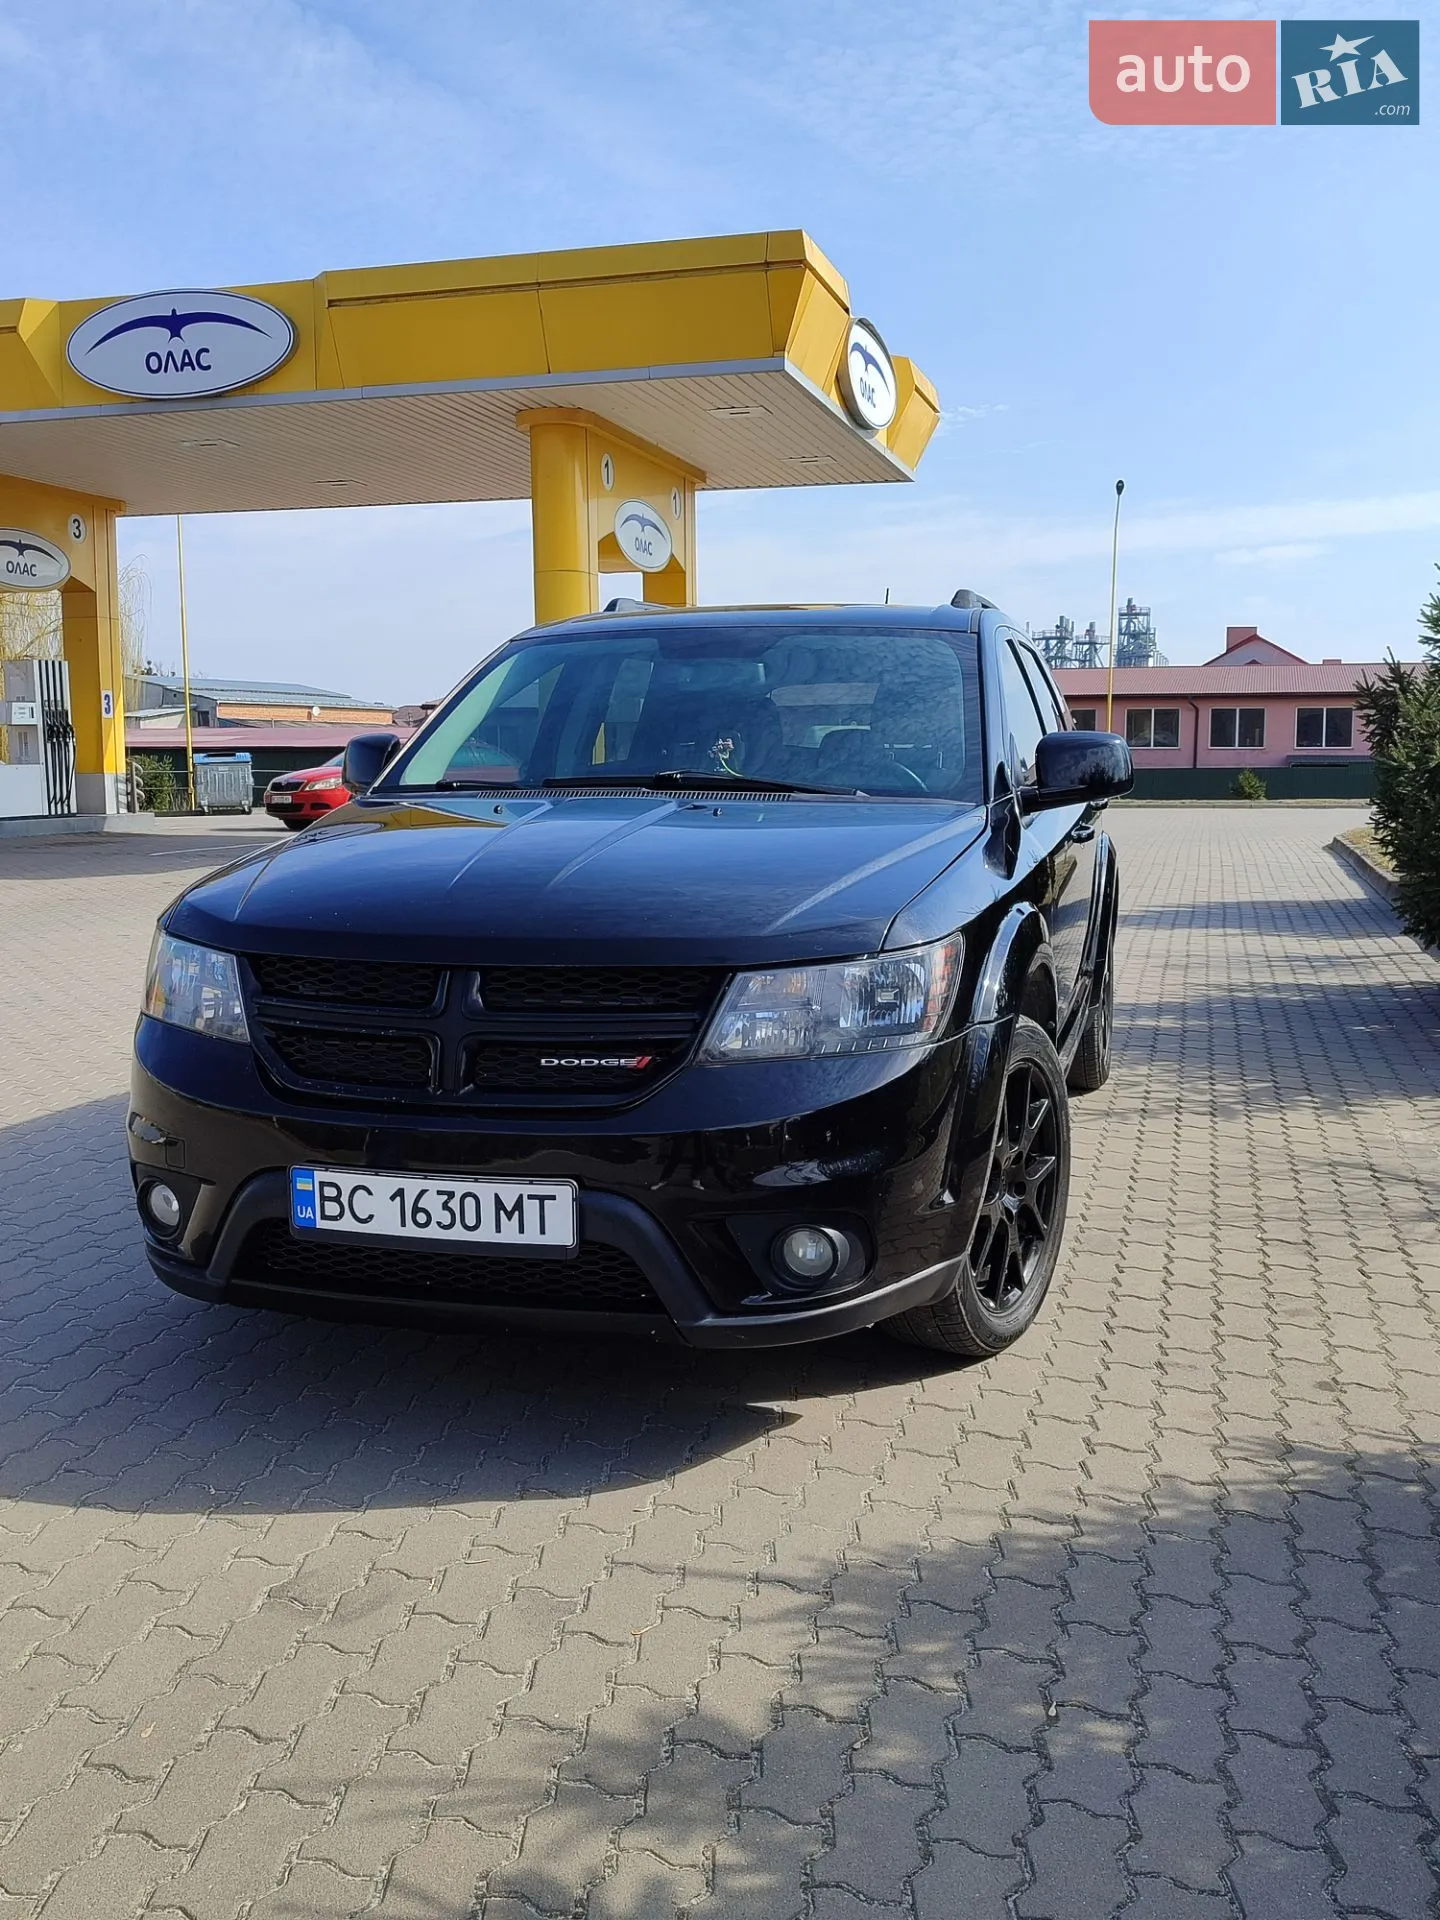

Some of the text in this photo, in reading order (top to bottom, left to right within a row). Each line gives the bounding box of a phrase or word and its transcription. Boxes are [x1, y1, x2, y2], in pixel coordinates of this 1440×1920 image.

[145, 347, 212, 375] ОЛАС
[604, 459, 610, 485] 1
[673, 491, 678, 516] 1
[72, 518, 82, 539] 3
[635, 537, 653, 556] ОЛАС
[6, 560, 37, 577] ОЛАС
[104, 693, 111, 715] 3
[540, 1058, 638, 1066] DODGE
[297, 1205, 314, 1220] UA
[318, 1180, 557, 1235] BC 1630 MT
